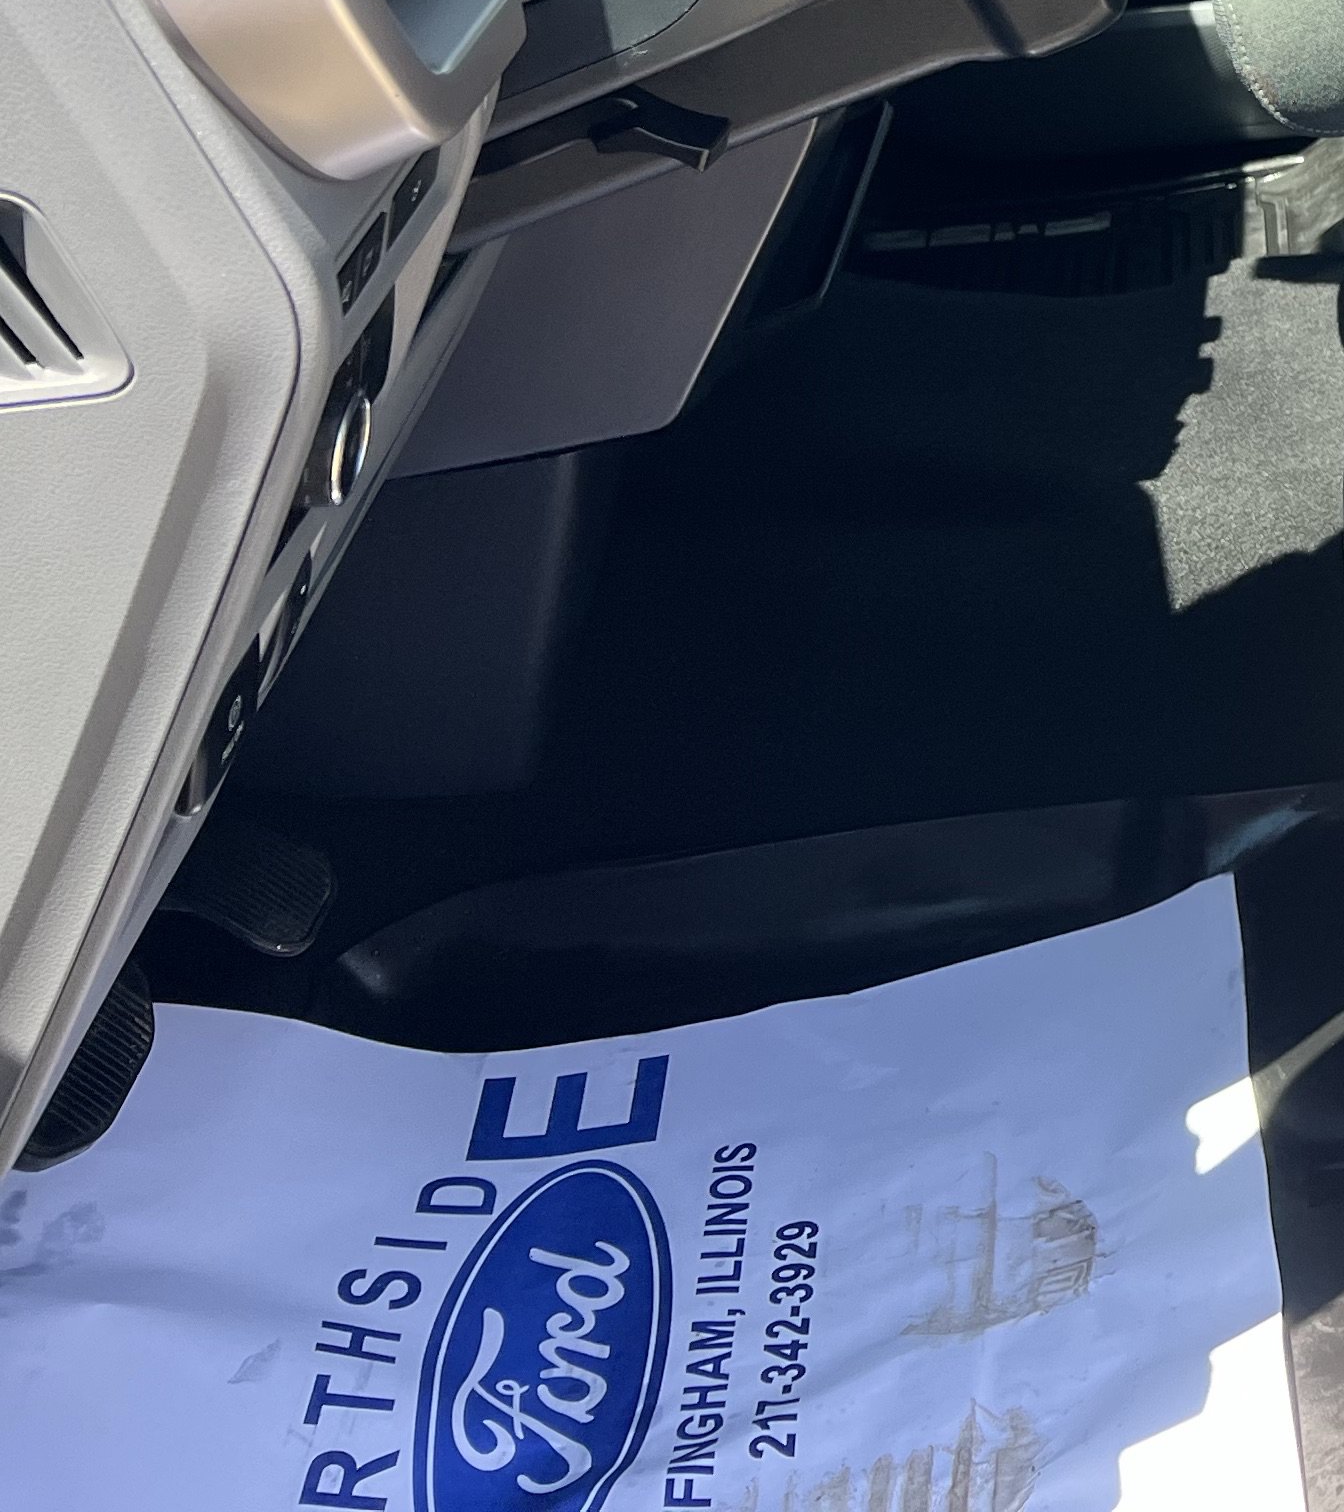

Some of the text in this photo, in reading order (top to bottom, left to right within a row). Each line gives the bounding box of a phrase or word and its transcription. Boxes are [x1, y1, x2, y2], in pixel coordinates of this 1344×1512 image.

[451, 1240, 631, 1494] Ford
[663, 1142, 757, 1508] FINGHAM, ILLINOIS
